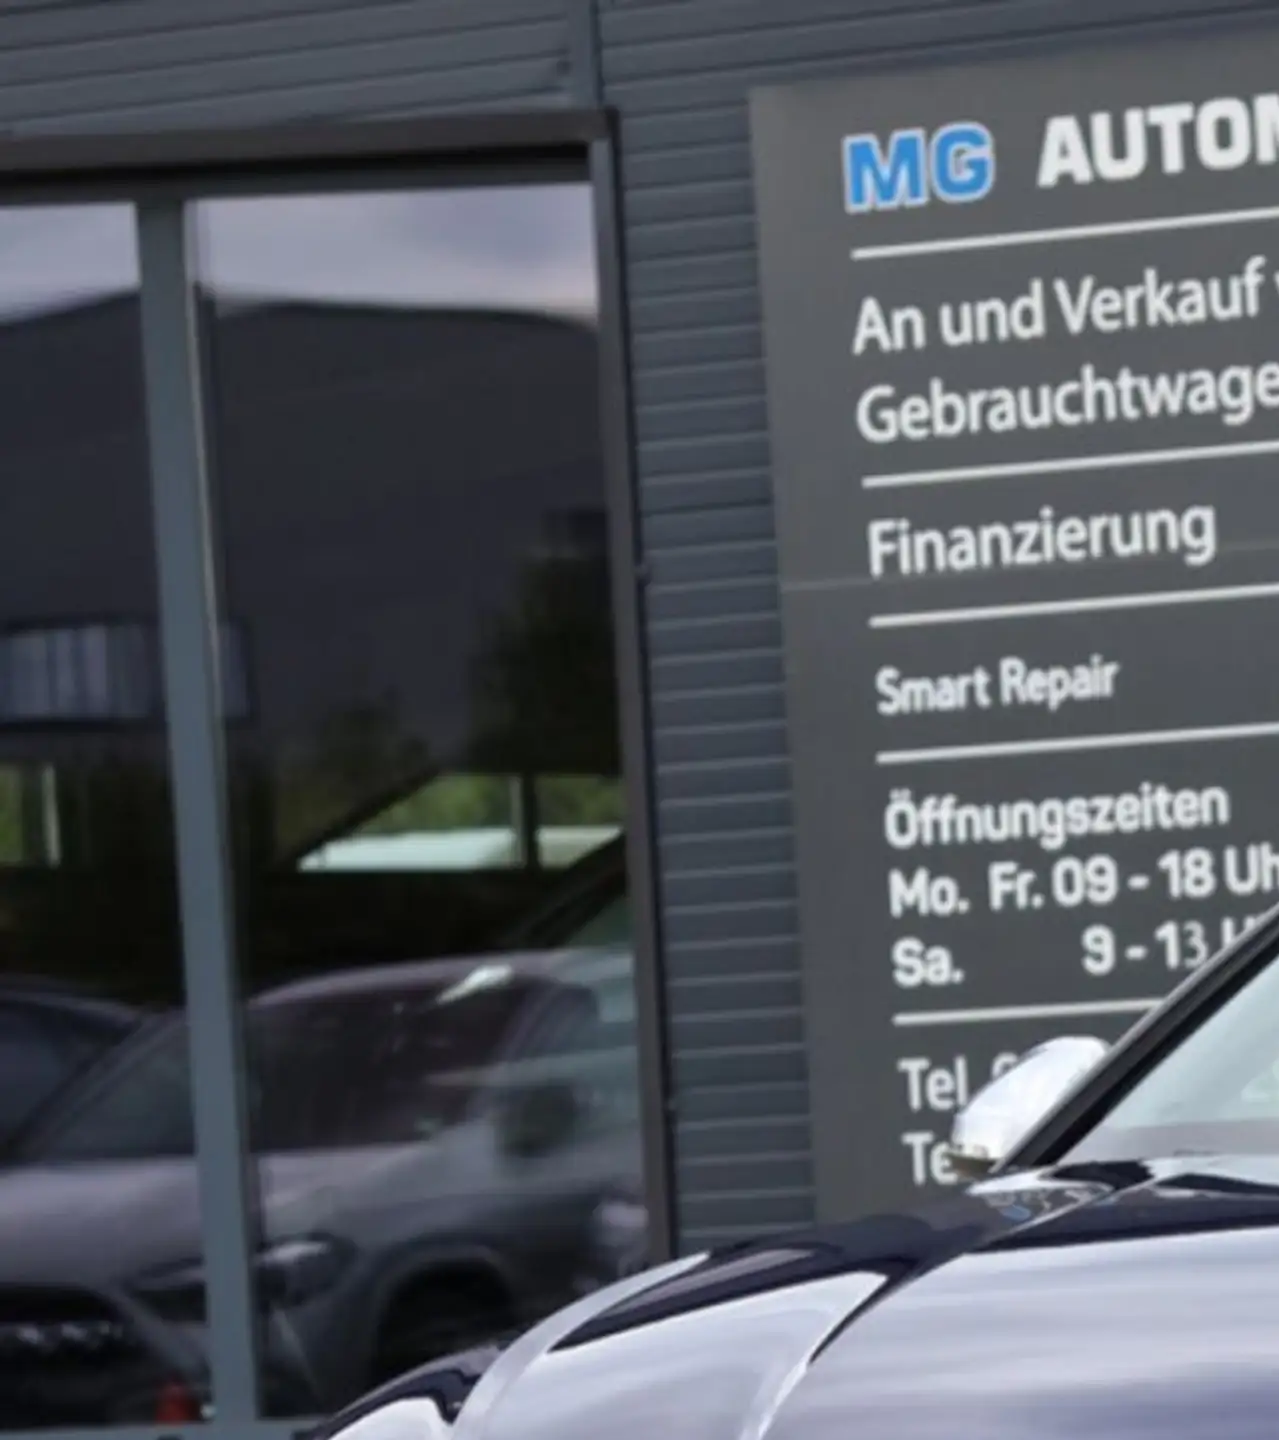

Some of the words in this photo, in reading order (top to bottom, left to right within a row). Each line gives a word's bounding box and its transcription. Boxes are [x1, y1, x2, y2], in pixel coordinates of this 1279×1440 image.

[841, 121, 996, 213] MG
[853, 297, 926, 354] An
[940, 279, 1045, 346] und
[1054, 256, 1265, 333] Verkauf
[867, 504, 1217, 580] Finanzierung
[875, 667, 991, 715] Smart
[999, 654, 1120, 710] Repair
[884, 781, 1231, 850] Öffnungszeiten
[889, 867, 969, 917] Mo.
[988, 861, 1044, 911] Fr.
[1052, 854, 1119, 906] 09
[1157, 847, 1217, 898] 18
[892, 938, 964, 987] Sa.
[1081, 924, 1117, 976] 9
[1155, 920, 1209, 969] 13
